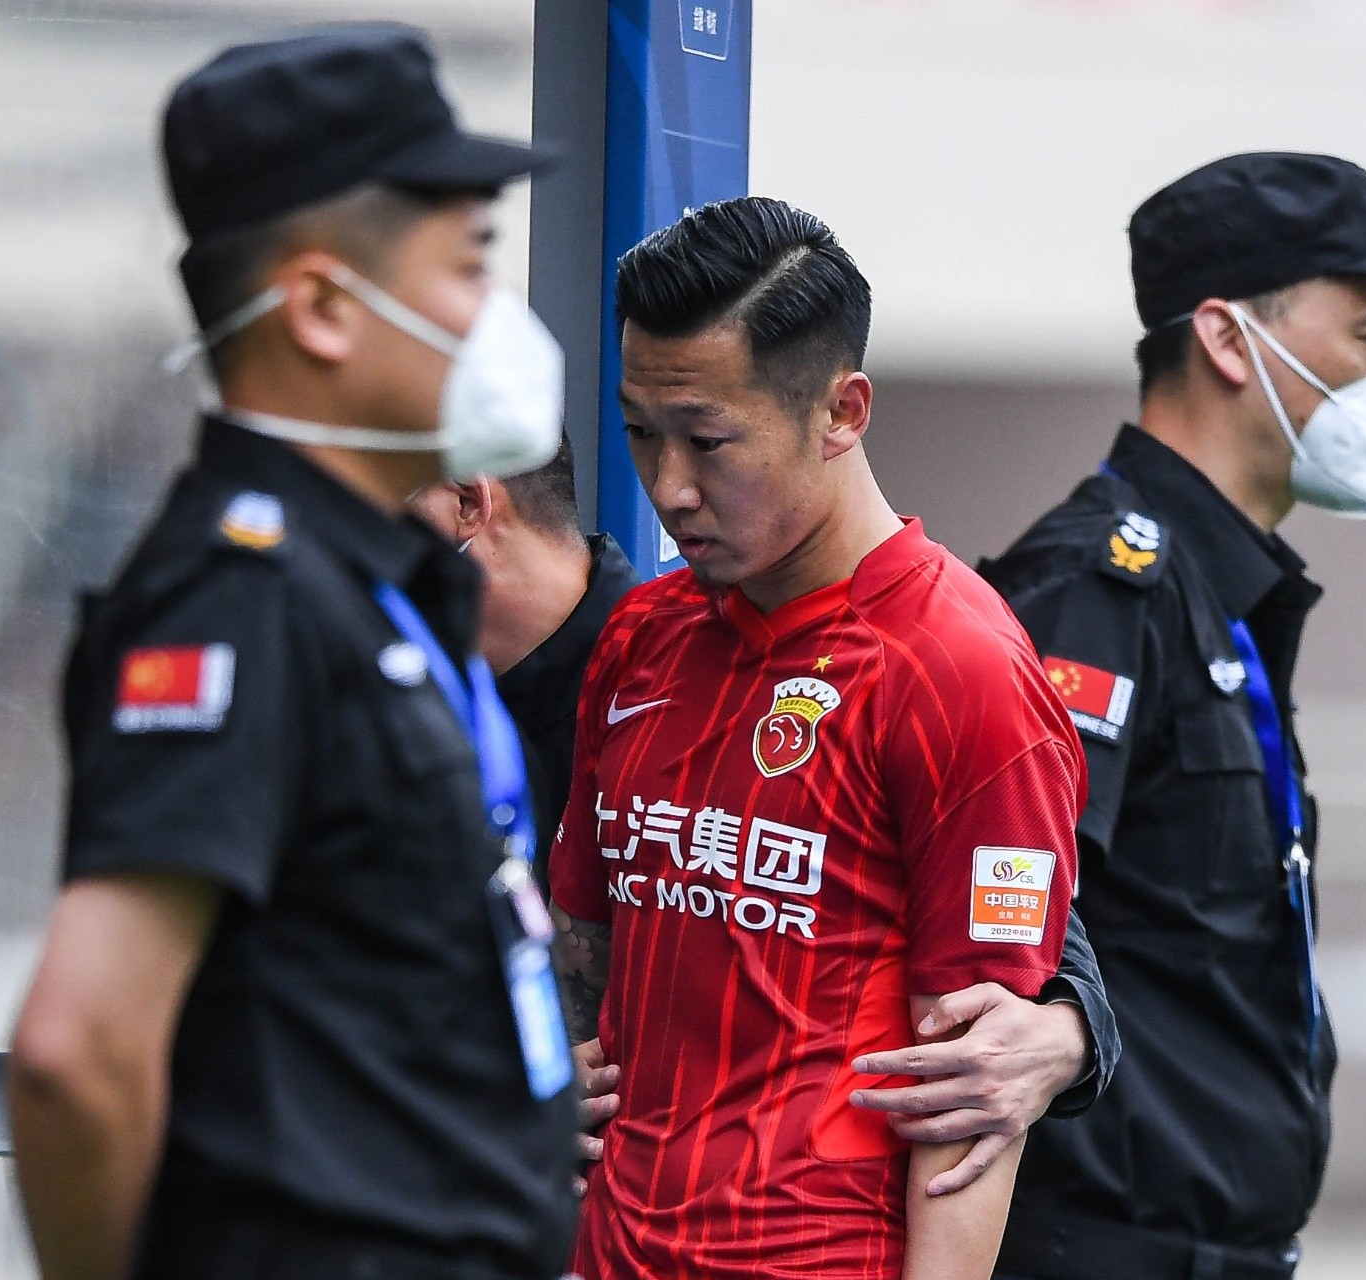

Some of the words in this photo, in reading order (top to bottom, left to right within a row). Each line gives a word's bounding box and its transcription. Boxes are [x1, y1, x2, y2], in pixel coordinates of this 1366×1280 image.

[656, 878, 816, 939] MOTOR
[984, 892, 1039, 910] 中国平安
